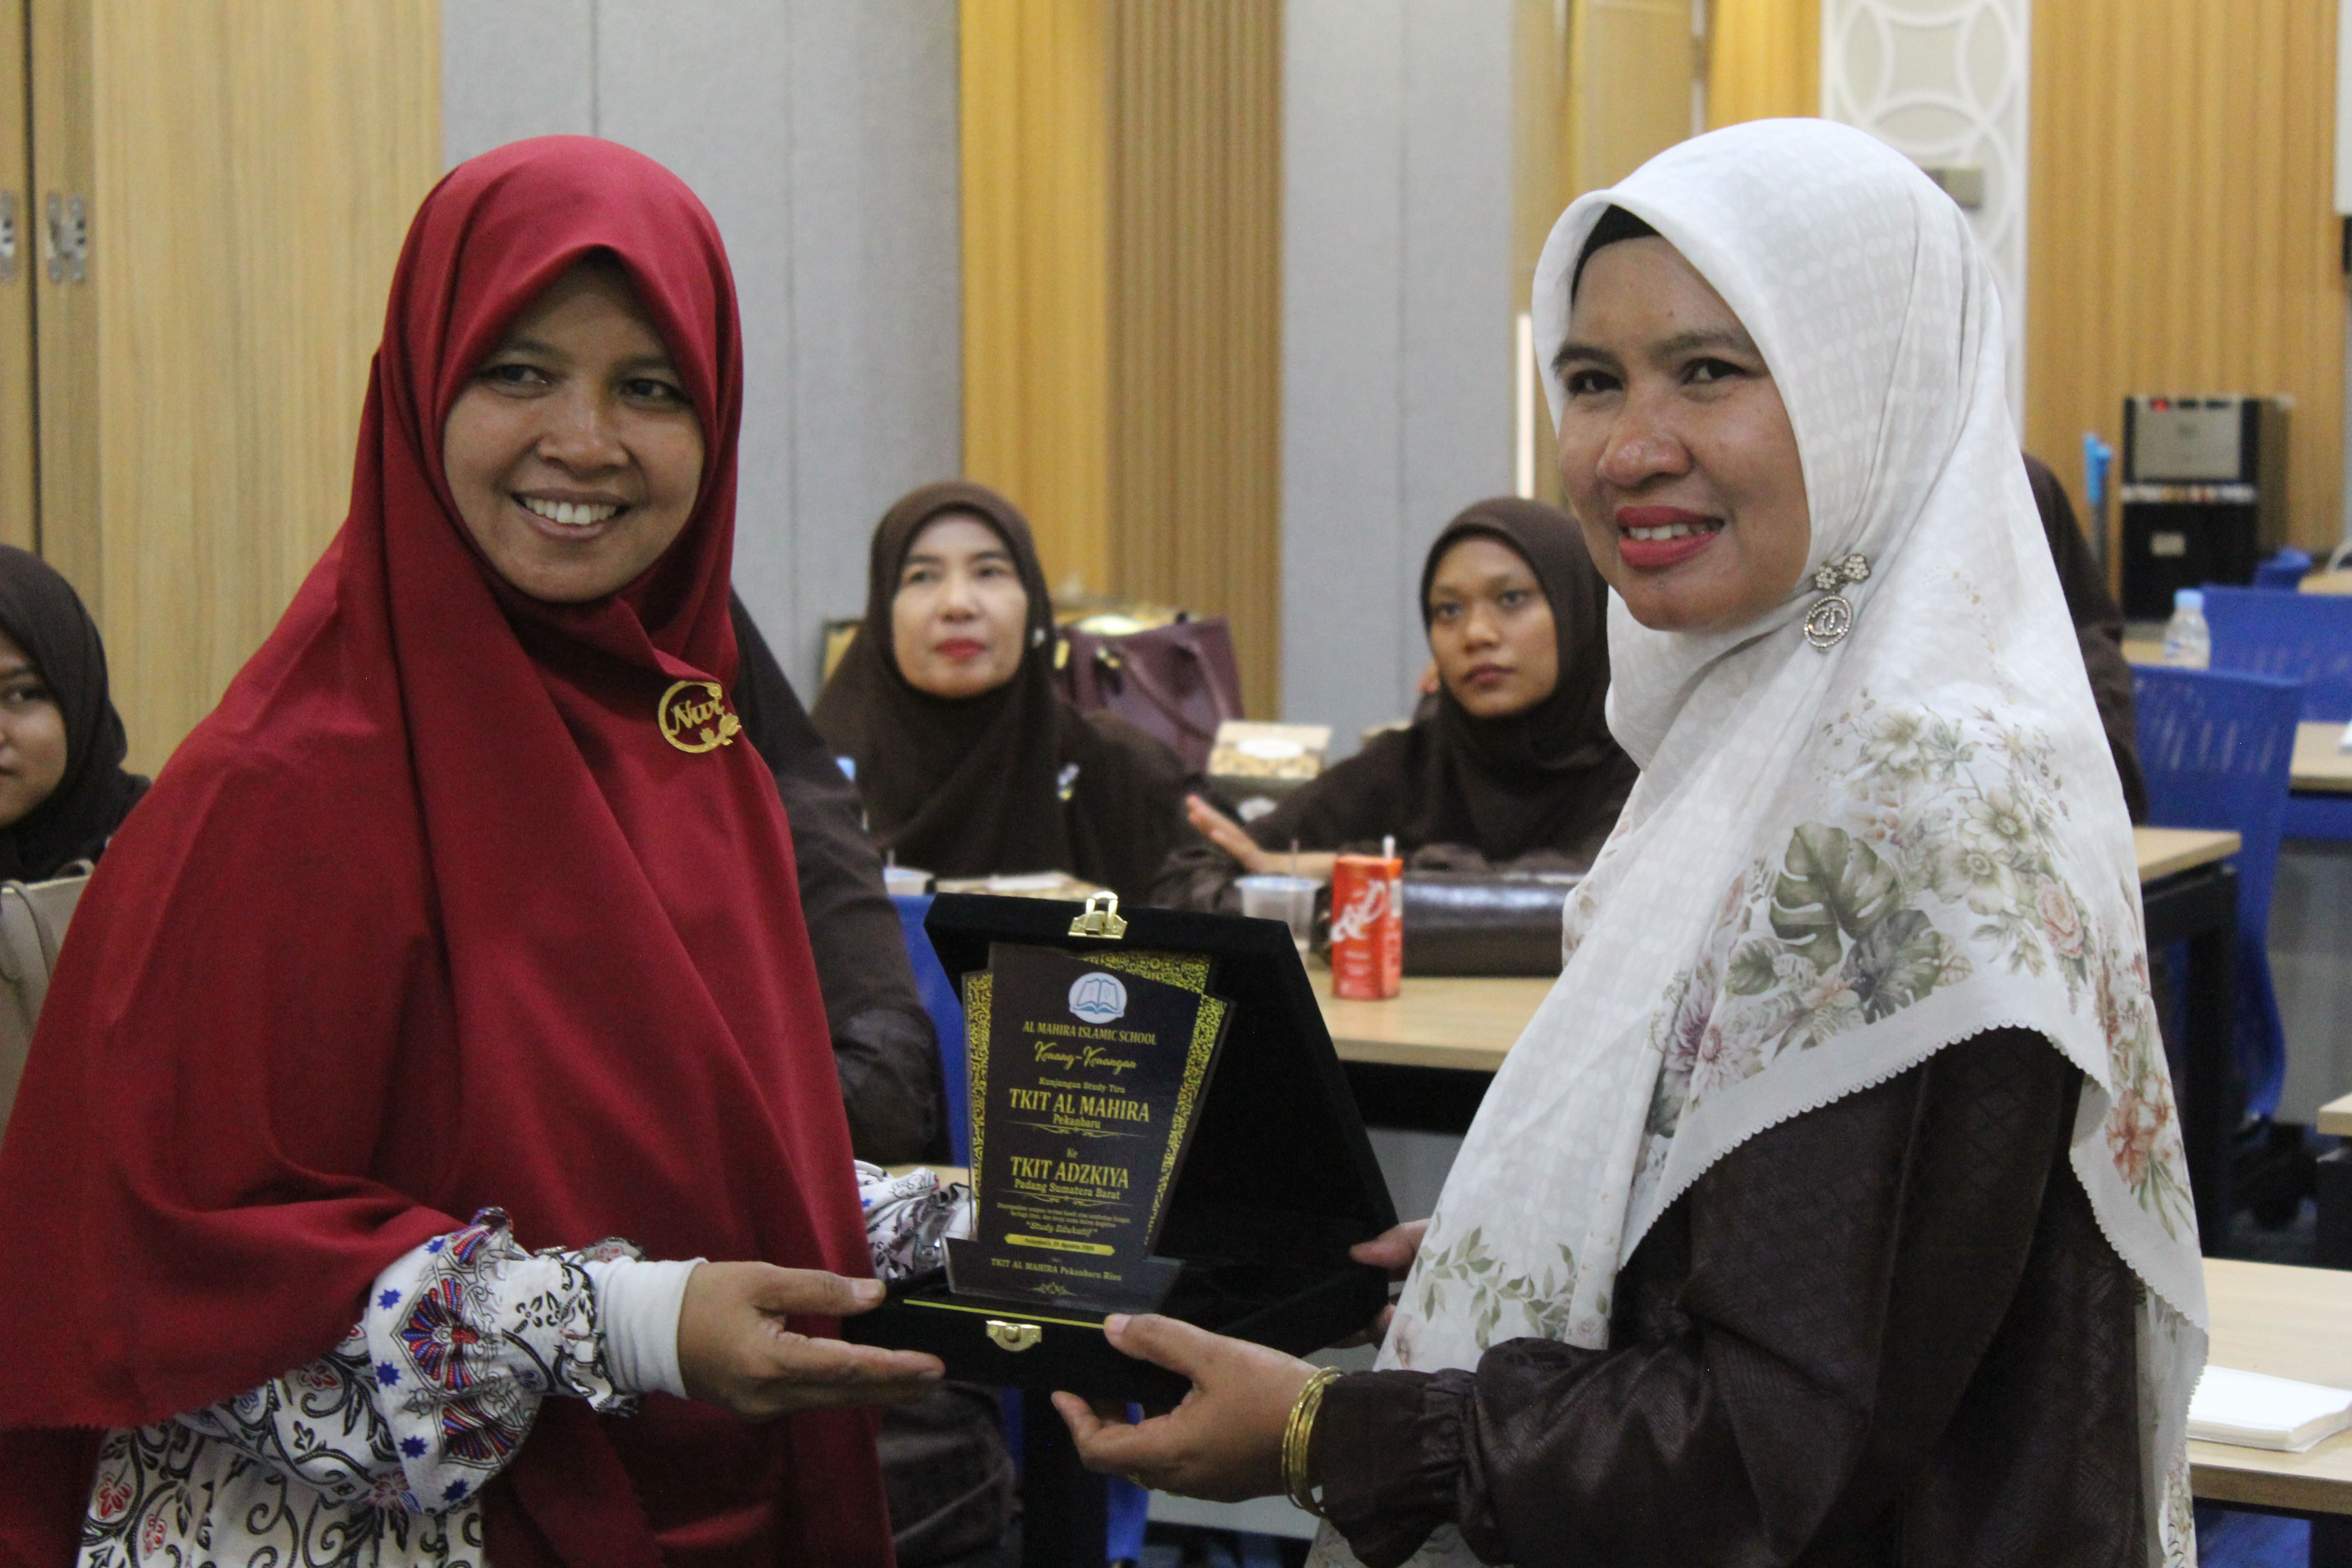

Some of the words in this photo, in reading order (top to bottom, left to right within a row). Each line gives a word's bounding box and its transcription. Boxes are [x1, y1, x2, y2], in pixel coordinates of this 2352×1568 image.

[1023, 1021, 1034, 1033] AL
[1037, 1022, 1076, 1037] MAHIRA
[1078, 1026, 1117, 1041] ISLAMIC
[1119, 1030, 1156, 1045] SCHOOL
[1009, 1088, 1051, 1111] TKIT
[1053, 1093, 1075, 1114] AL
[1079, 1095, 1150, 1122] MAHIRA
[1053, 1113, 1101, 1129] Pekanbaru
[1010, 1156, 1053, 1179] TKIT
[1054, 1161, 1129, 1189] ADZKIYA
[1014, 1178, 1047, 1194] Padang
[1095, 1187, 1121, 1200] Barat
[1012, 1261, 1023, 1269] AL
